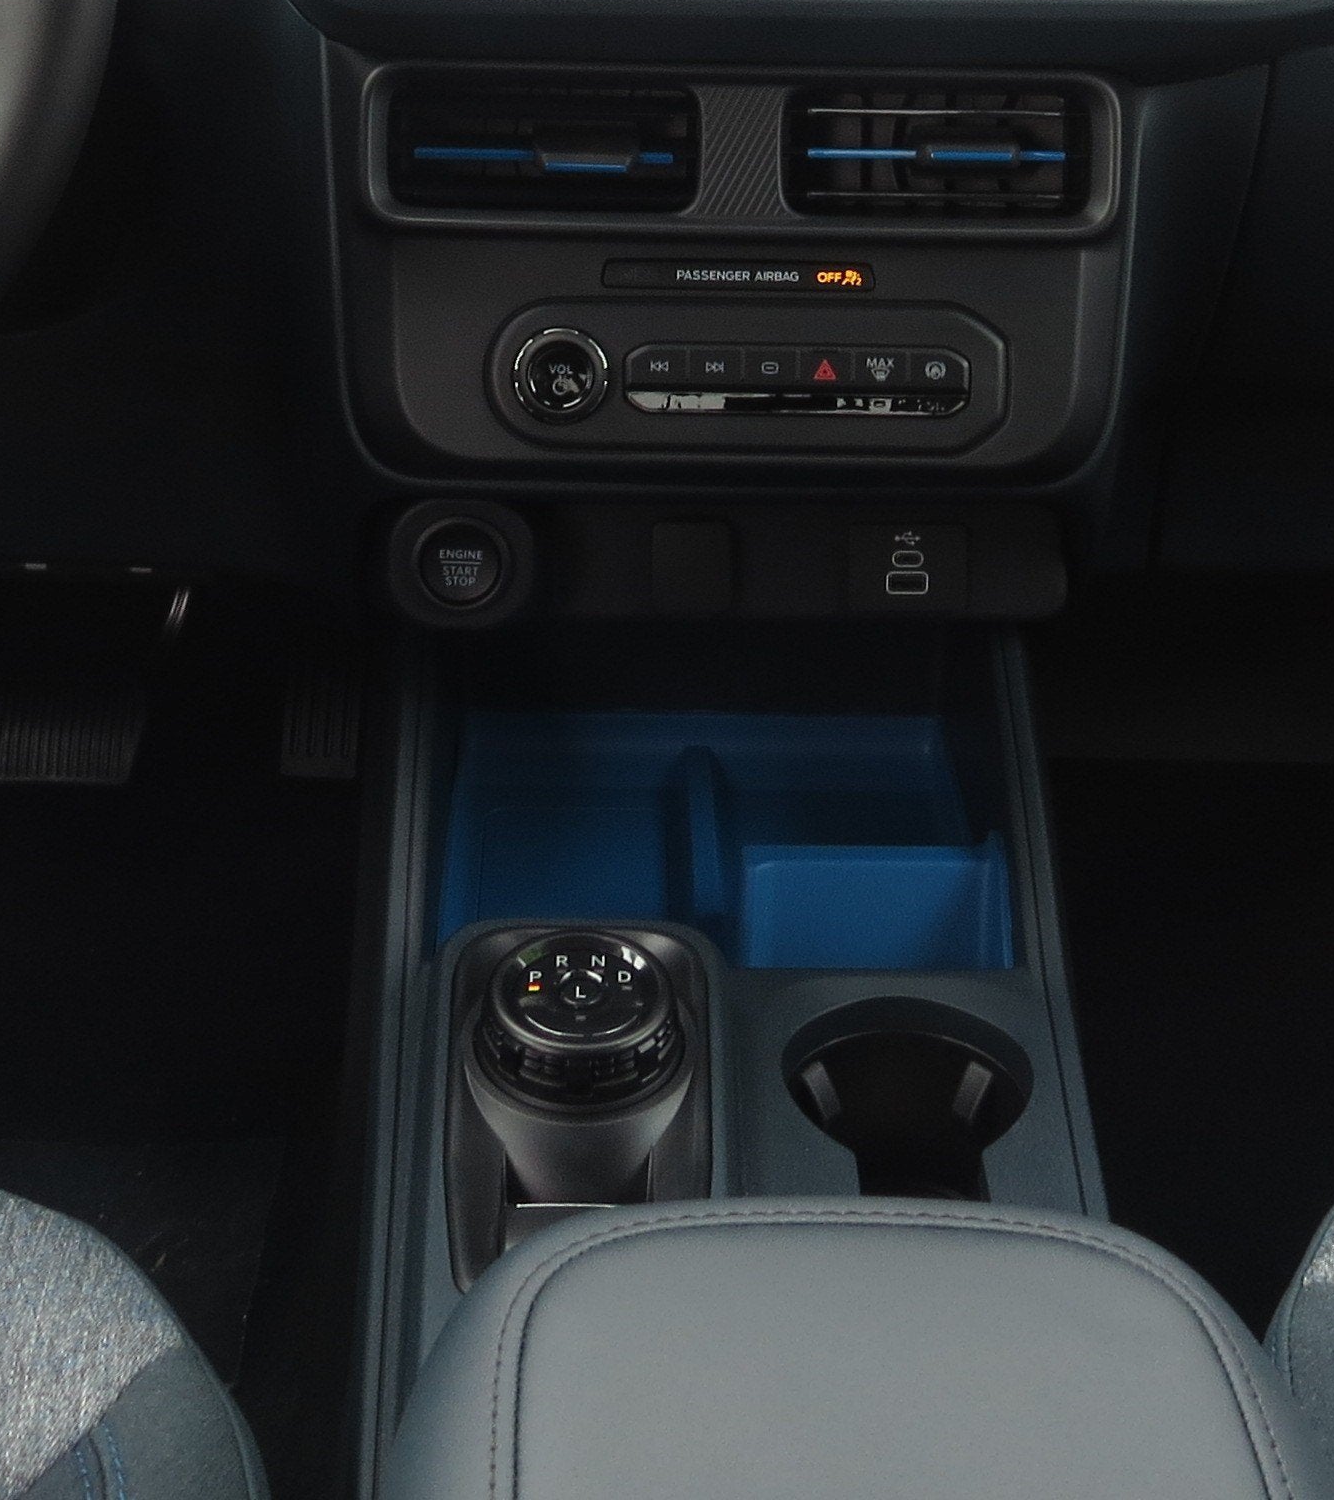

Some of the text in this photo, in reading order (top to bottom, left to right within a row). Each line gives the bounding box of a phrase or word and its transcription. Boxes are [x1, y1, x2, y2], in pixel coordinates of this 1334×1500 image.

[675, 269, 800, 282] PASSENGER AIRBAG
[816, 271, 842, 284] OFF
[548, 363, 574, 375] VOL
[866, 357, 895, 369] MAX
[438, 548, 484, 560] ENGINE
[442, 565, 479, 577] START
[444, 576, 477, 587] STOP
[555, 954, 605, 968] R N
[528, 970, 543, 984] P
[617, 970, 633, 984] D
[575, 985, 587, 999] L
